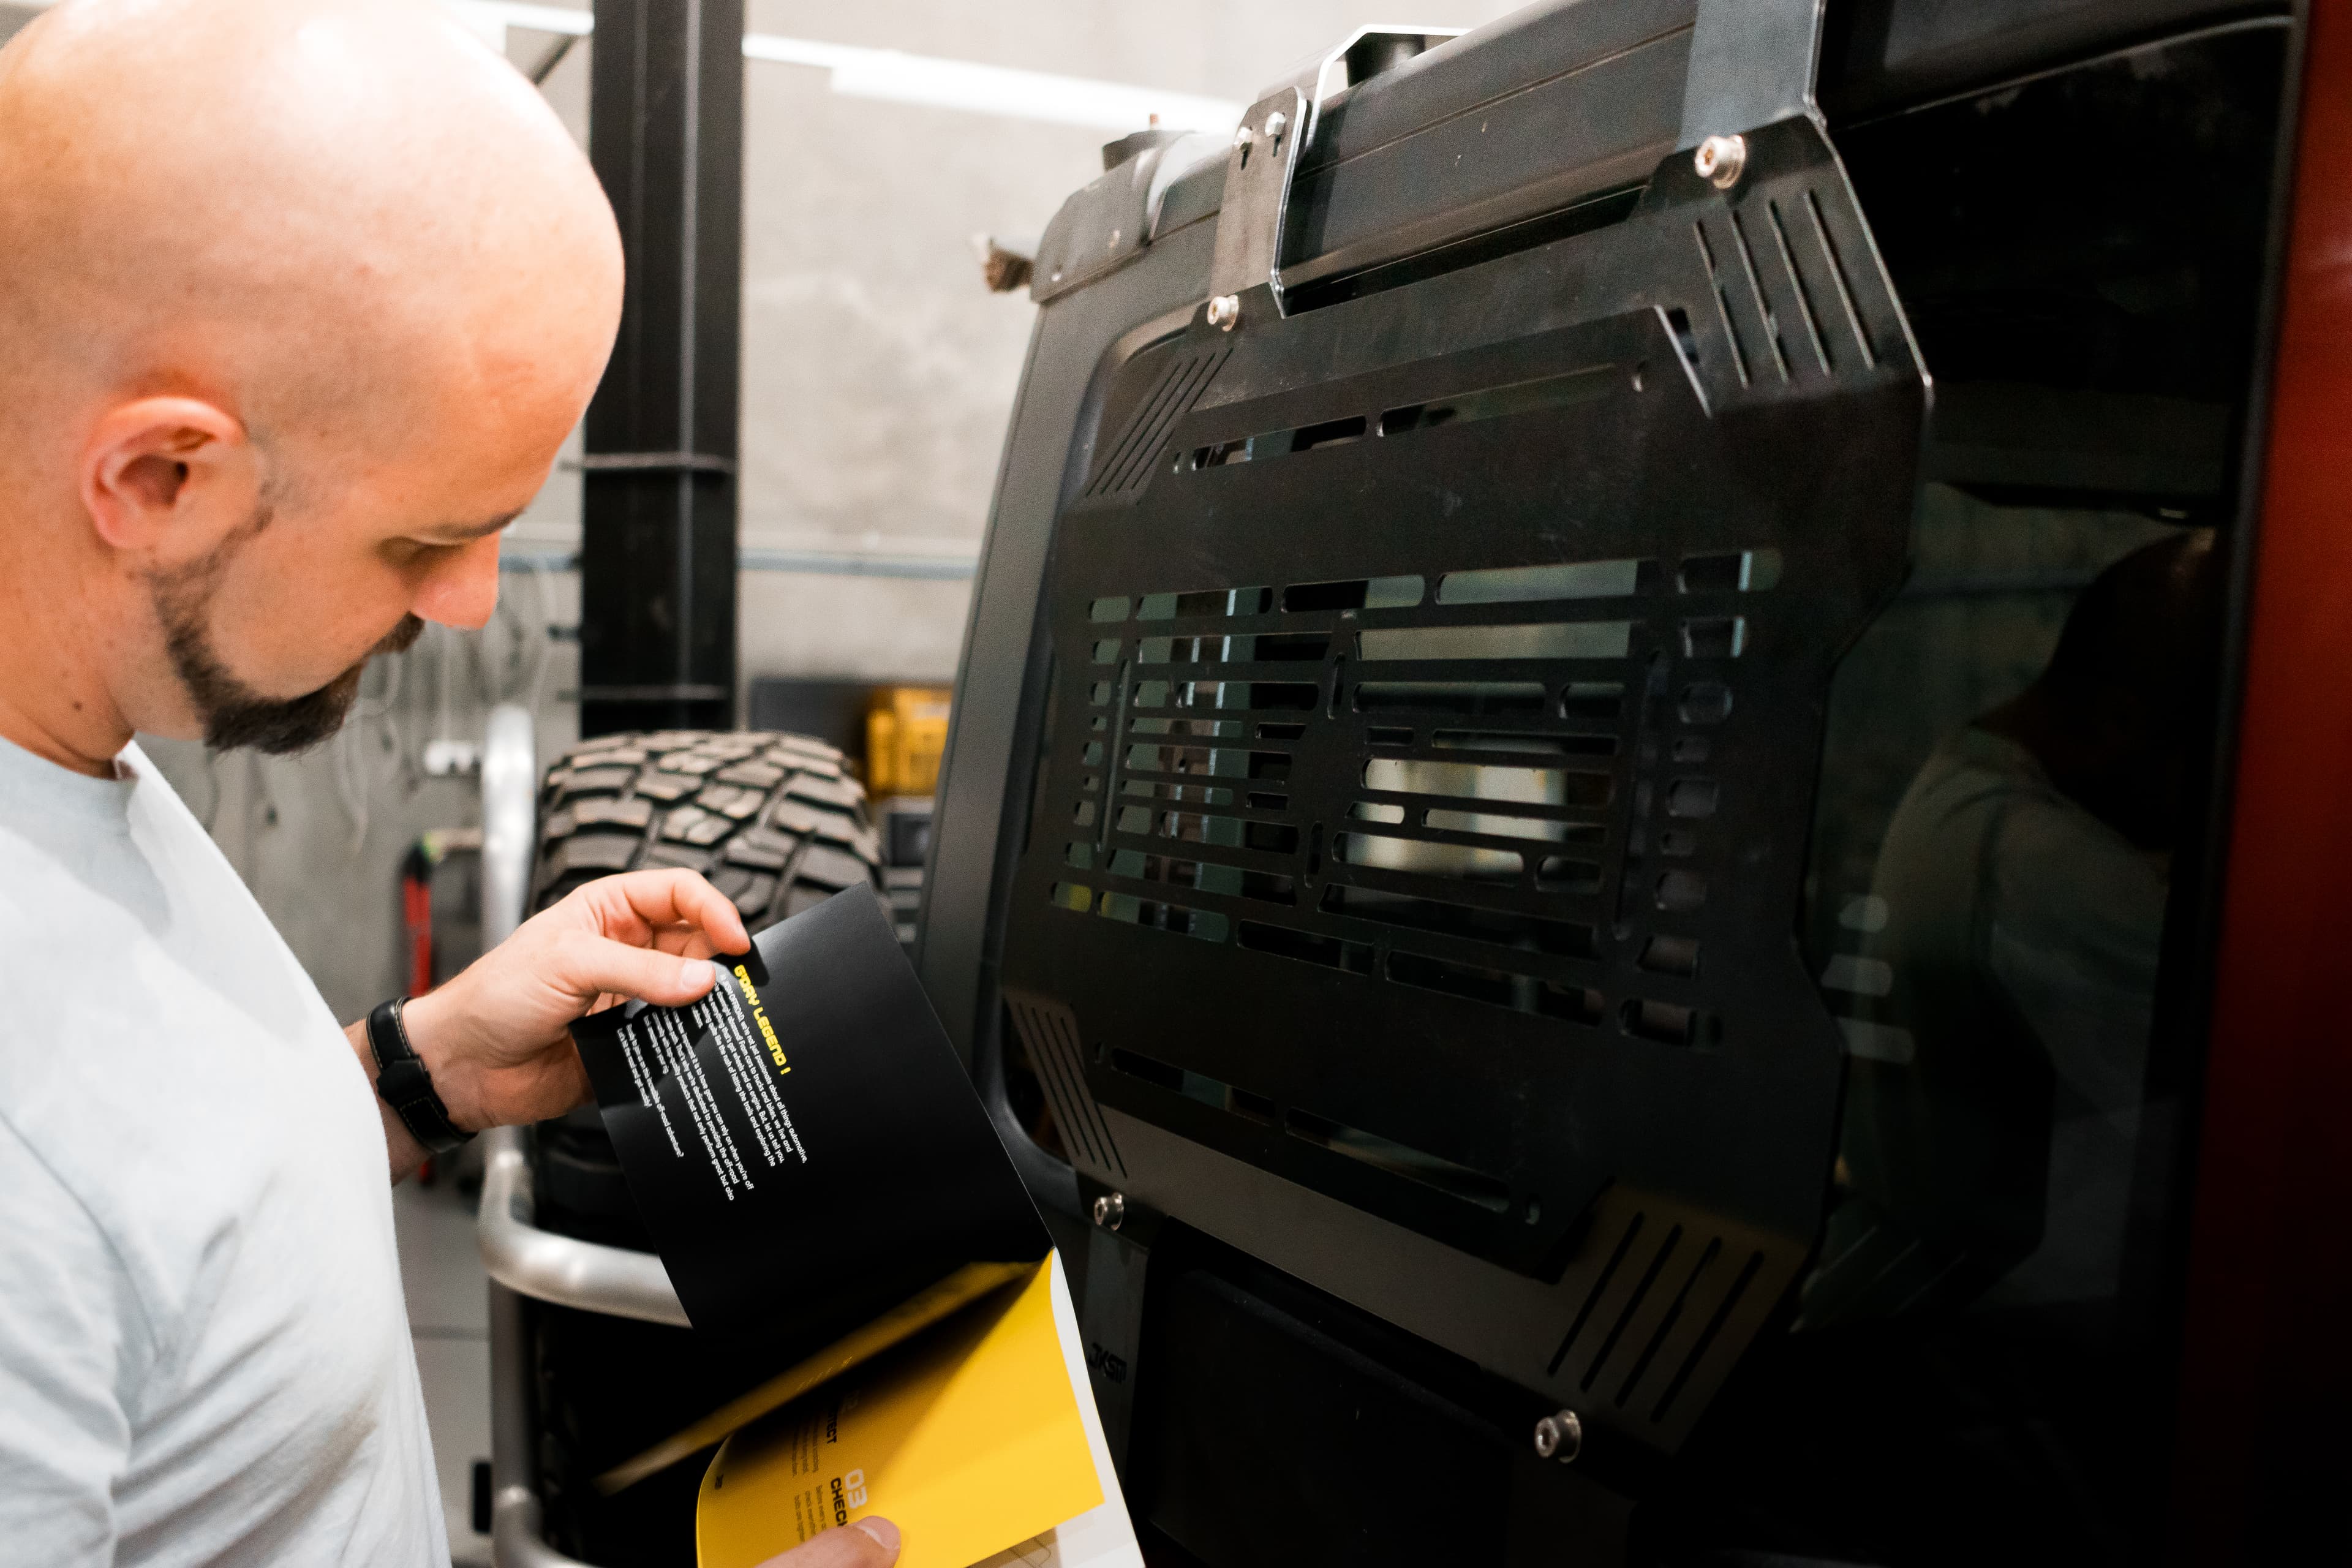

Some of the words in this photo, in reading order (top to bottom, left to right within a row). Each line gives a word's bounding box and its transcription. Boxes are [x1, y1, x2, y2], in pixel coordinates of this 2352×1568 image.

[710, 1001, 725, 1029] everything
[734, 965, 760, 1006] G'DAY
[753, 1006, 786, 1066] LEGEND
[722, 1026, 732, 1043] that's
[741, 1020, 750, 1036] we're
[662, 1036, 670, 1049] with
[726, 1042, 737, 1053] got
[747, 1035, 755, 1046] not
[676, 1043, 685, 1061] That's
[749, 1044, 760, 1055] just
[627, 1055, 636, 1069] road
[657, 1053, 666, 1065] your
[733, 1052, 745, 1071] wheels
[631, 1068, 641, 1079] and
[741, 1071, 751, 1083] and
[754, 1054, 772, 1085] passionate
[635, 1077, 643, 1088] get
[687, 1071, 696, 1087] we're
[745, 1082, 753, 1091] an
[676, 1075, 691, 1100] products
[769, 1084, 781, 1102] about
[693, 1085, 709, 1114] dedicated
[738, 1039, 748, 1056] From
[745, 1055, 753, 1068] cars
[753, 1073, 764, 1091] trucks
[761, 1091, 771, 1104] and
[766, 1102, 776, 1120] bikes,
[774, 1119, 781, 1129] we
[783, 1139, 793, 1153] and
[749, 1090, 761, 1112] engine.
[639, 1061, 646, 1069] on
[657, 1103, 671, 1127] off-road
[666, 1126, 684, 1157] adventure?
[682, 1033, 696, 1060] important
[699, 1074, 708, 1089] have
[704, 1088, 714, 1102] gear
[709, 1102, 718, 1114] you
[720, 1124, 729, 1136] rely
[725, 1136, 732, 1145] on
[729, 1144, 739, 1162] when
[735, 1161, 748, 1180] you're
[745, 1180, 754, 1189] off
[687, 1098, 696, 1112] that
[723, 1054, 732, 1068] rush
[731, 1072, 742, 1092] hitting
[743, 1101, 753, 1117] trails
[750, 1116, 760, 1128] and
[755, 1128, 771, 1156] exploring
[777, 1101, 785, 1110] all
[692, 1111, 701, 1123] not
[704, 1112, 710, 1121] to
[758, 1110, 767, 1124] But,
[780, 1109, 792, 1128] things
[697, 1121, 706, 1135] only
[706, 1120, 722, 1148] providing
[768, 1131, 775, 1140] us
[701, 1134, 716, 1159] perform
[771, 1139, 781, 1150] tell
[788, 1128, 807, 1163] automotive,
[775, 1149, 785, 1163] you,
[711, 1158, 724, 1176] great
[724, 1158, 740, 1184] off-road
[720, 1174, 729, 1187] but
[725, 1186, 734, 1200] also
[845, 1468, 867, 1509] 03
